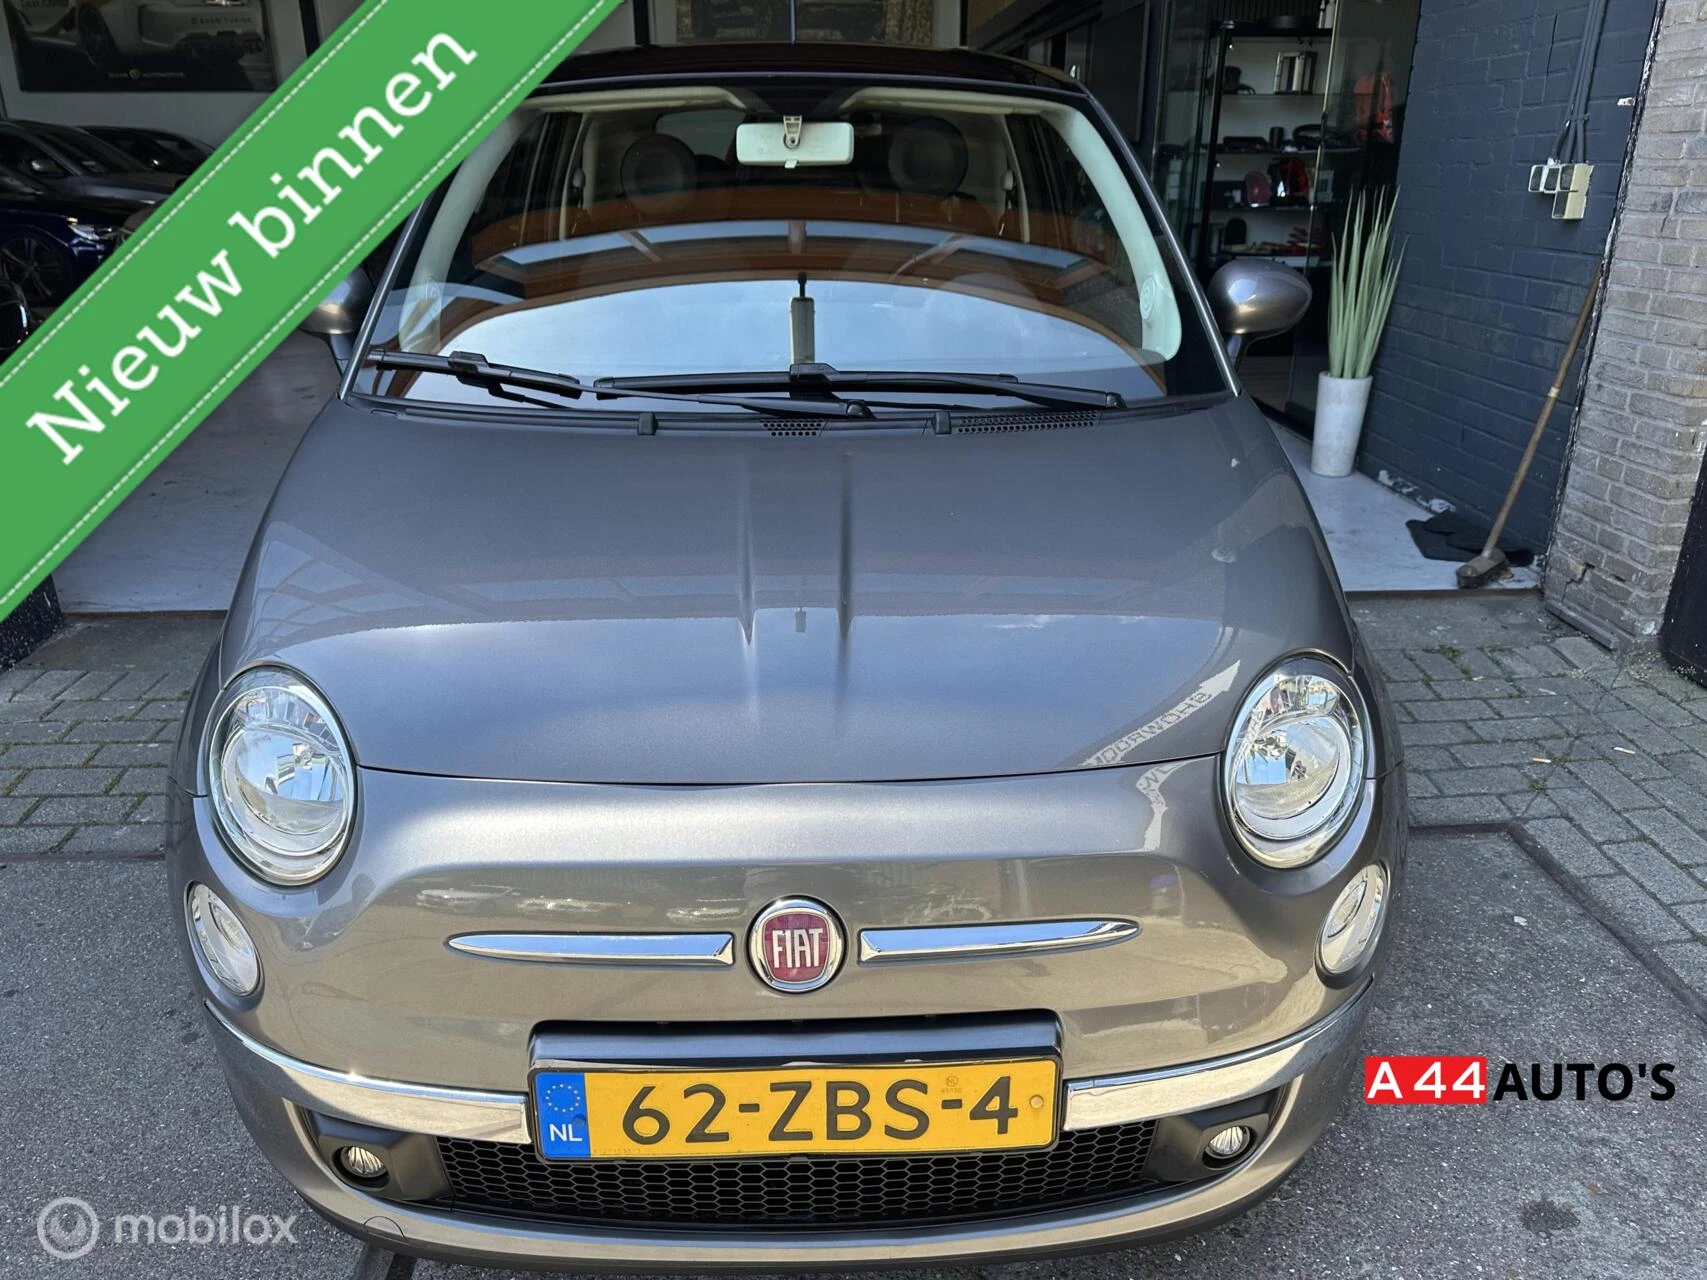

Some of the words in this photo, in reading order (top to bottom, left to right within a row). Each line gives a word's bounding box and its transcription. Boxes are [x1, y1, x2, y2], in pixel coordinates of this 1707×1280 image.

[772, 928, 823, 968] FIAT
[549, 1125, 583, 1142] NL
[621, 1075, 1019, 1144] 62-ZBS-4
